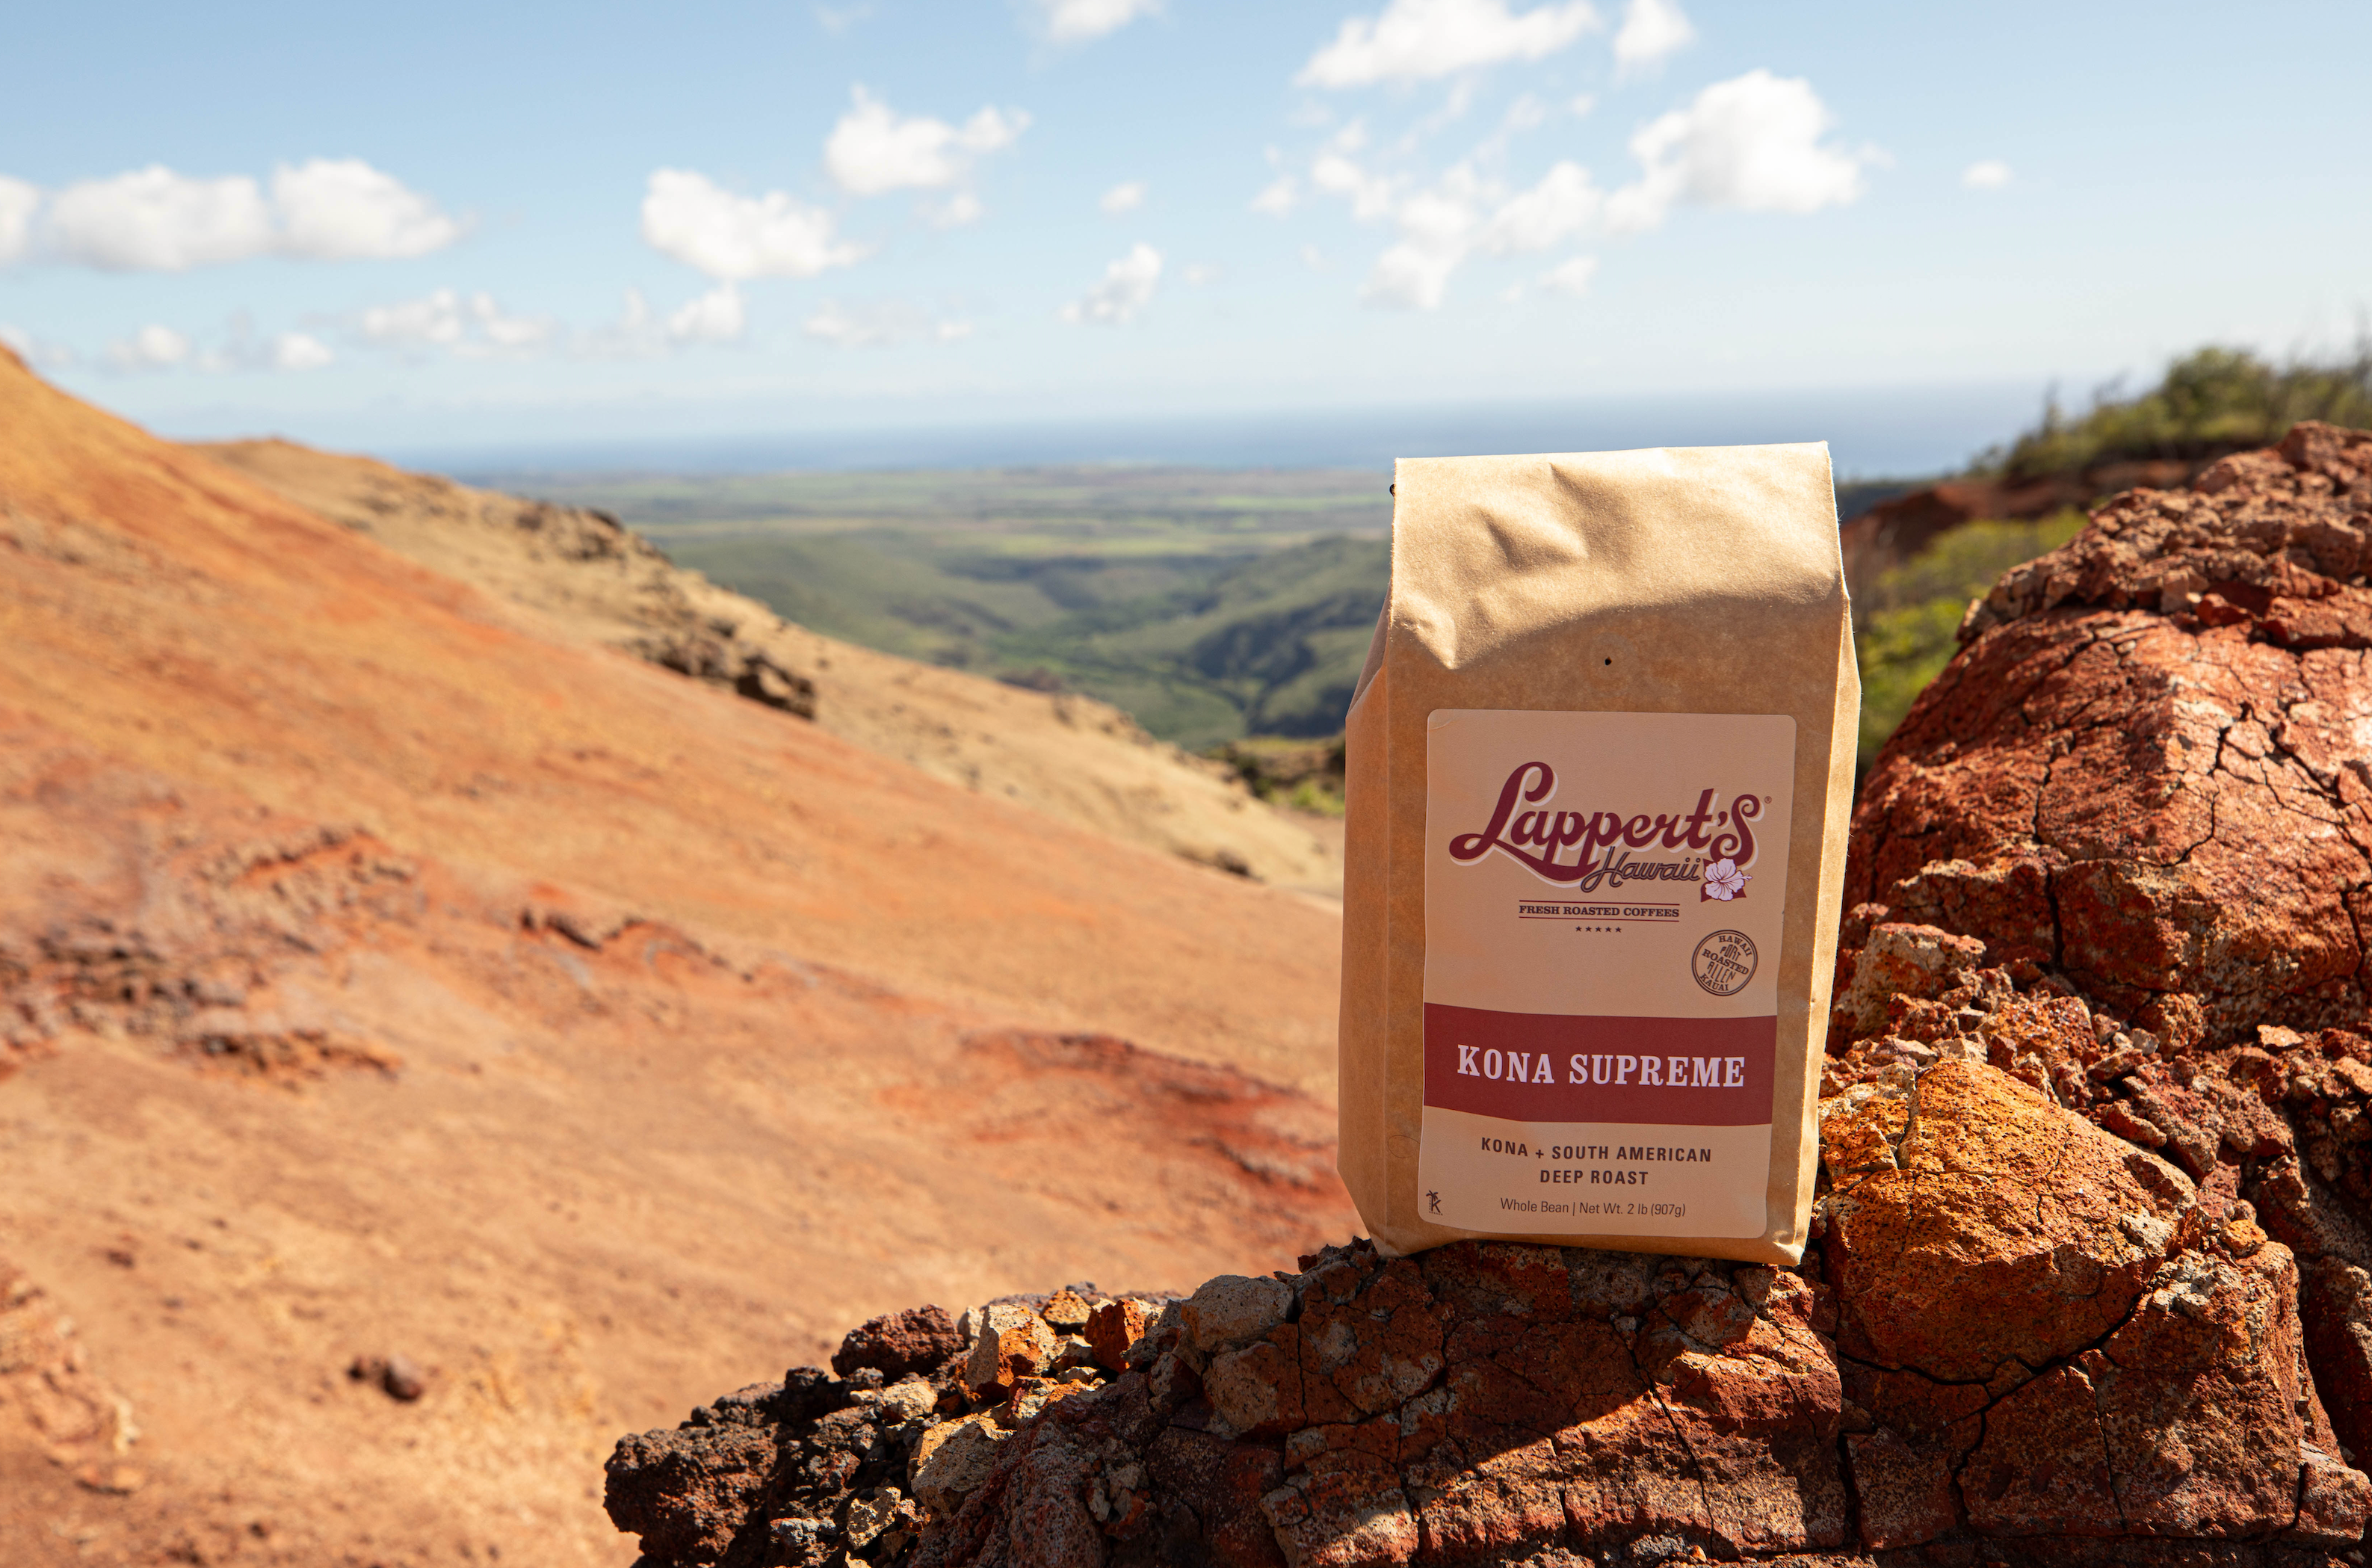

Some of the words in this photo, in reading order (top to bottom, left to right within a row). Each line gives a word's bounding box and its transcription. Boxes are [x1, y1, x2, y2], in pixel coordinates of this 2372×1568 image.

[1580, 845, 1701, 893] Hawaii
[1519, 904, 1560, 915] FRESH
[1563, 906, 1620, 916] ROASTED
[1622, 907, 1680, 918] COFFEES
[1718, 935, 1752, 957] HAWAII
[1720, 944, 1741, 962] PORT
[1701, 948, 1749, 975] ROASTED
[1706, 961, 1737, 984] ALLEN
[1699, 973, 1729, 991] KAUAI
[1457, 1043, 1555, 1084] KONA
[1568, 1053, 1746, 1088] SUPREME
[1480, 1136, 1529, 1157] KONA
[1535, 1149, 1545, 1159] +
[1551, 1145, 1609, 1160] SOUTH
[1616, 1146, 1712, 1163] AMERICAN
[1539, 1170, 1584, 1183] DEEP
[1590, 1170, 1649, 1185] ROAST
[1500, 1197, 1538, 1212] Whole
[1540, 1200, 1569, 1214] Bean
[1579, 1202, 1600, 1214] Net
[1603, 1203, 1623, 1214] Wt.
[1627, 1203, 1634, 1215] 2
[1637, 1203, 1648, 1215] lb
[1650, 1203, 1686, 1217] (907g)
